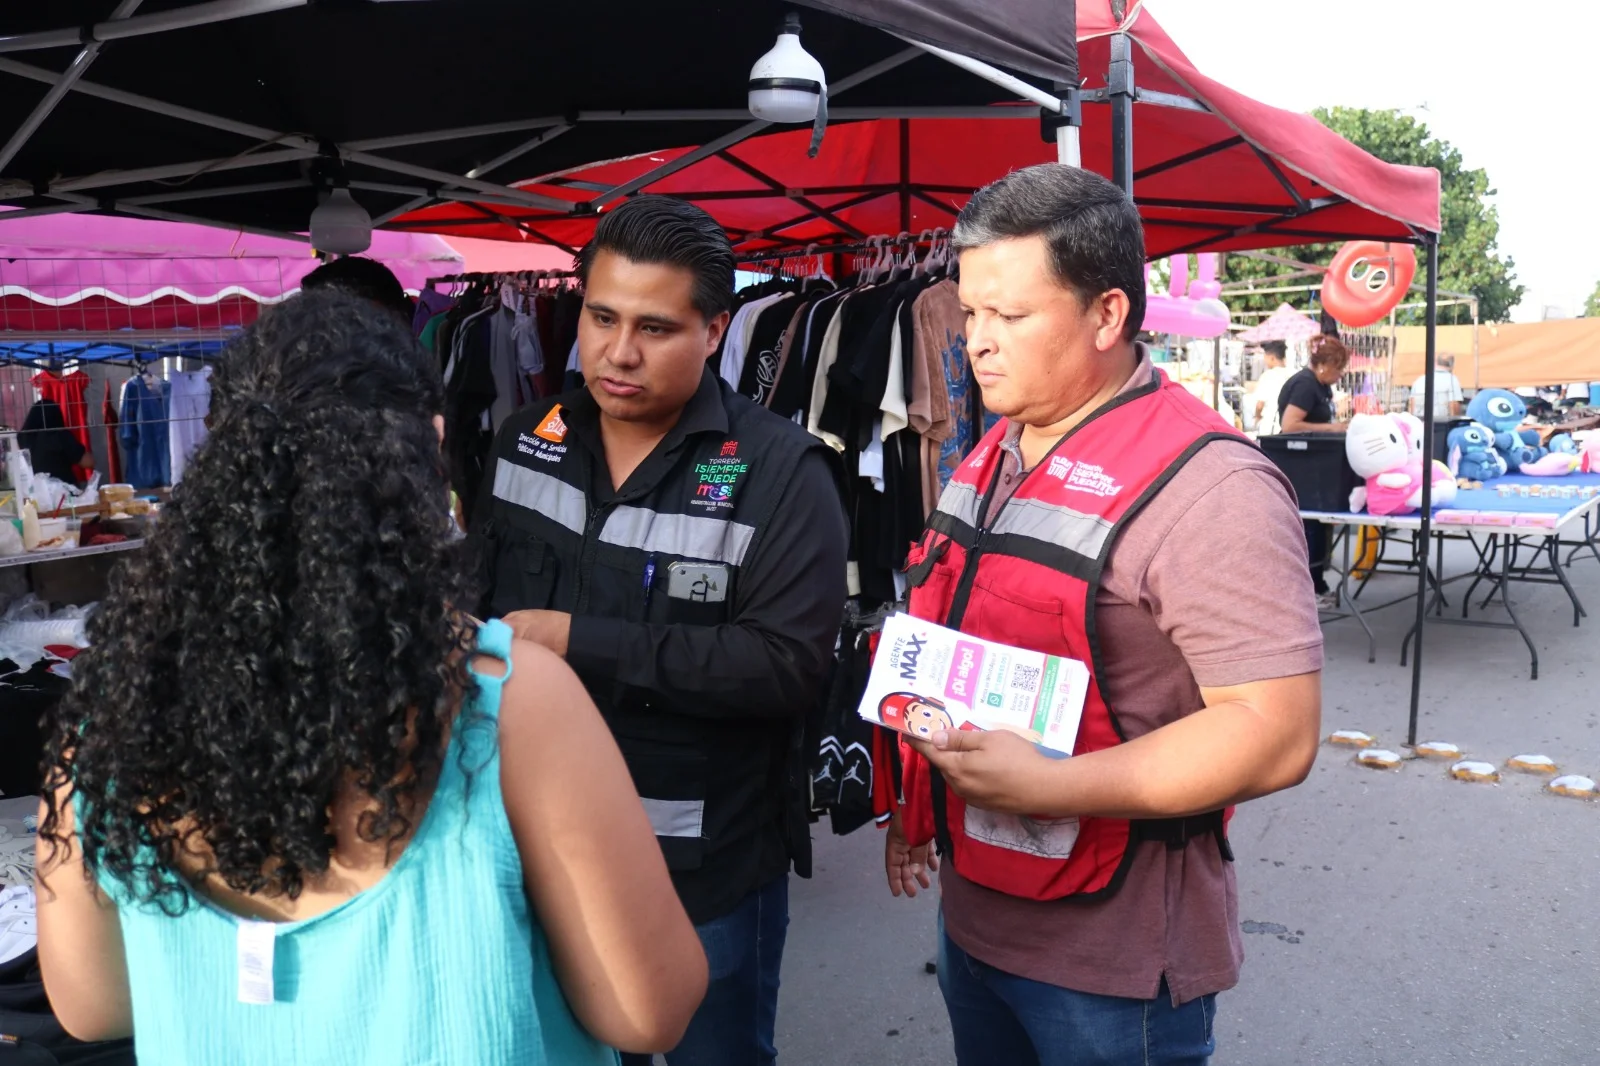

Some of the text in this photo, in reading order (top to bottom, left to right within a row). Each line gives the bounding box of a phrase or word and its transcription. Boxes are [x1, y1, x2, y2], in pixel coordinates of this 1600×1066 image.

[540, 442, 548, 450] de
[548, 444, 567, 453] Servicios
[699, 474, 737, 483] PUEDE
[891, 637, 906, 668] AGENTE
[900, 633, 927, 680] MAX
[954, 647, 975, 696] ¡Di algo!
